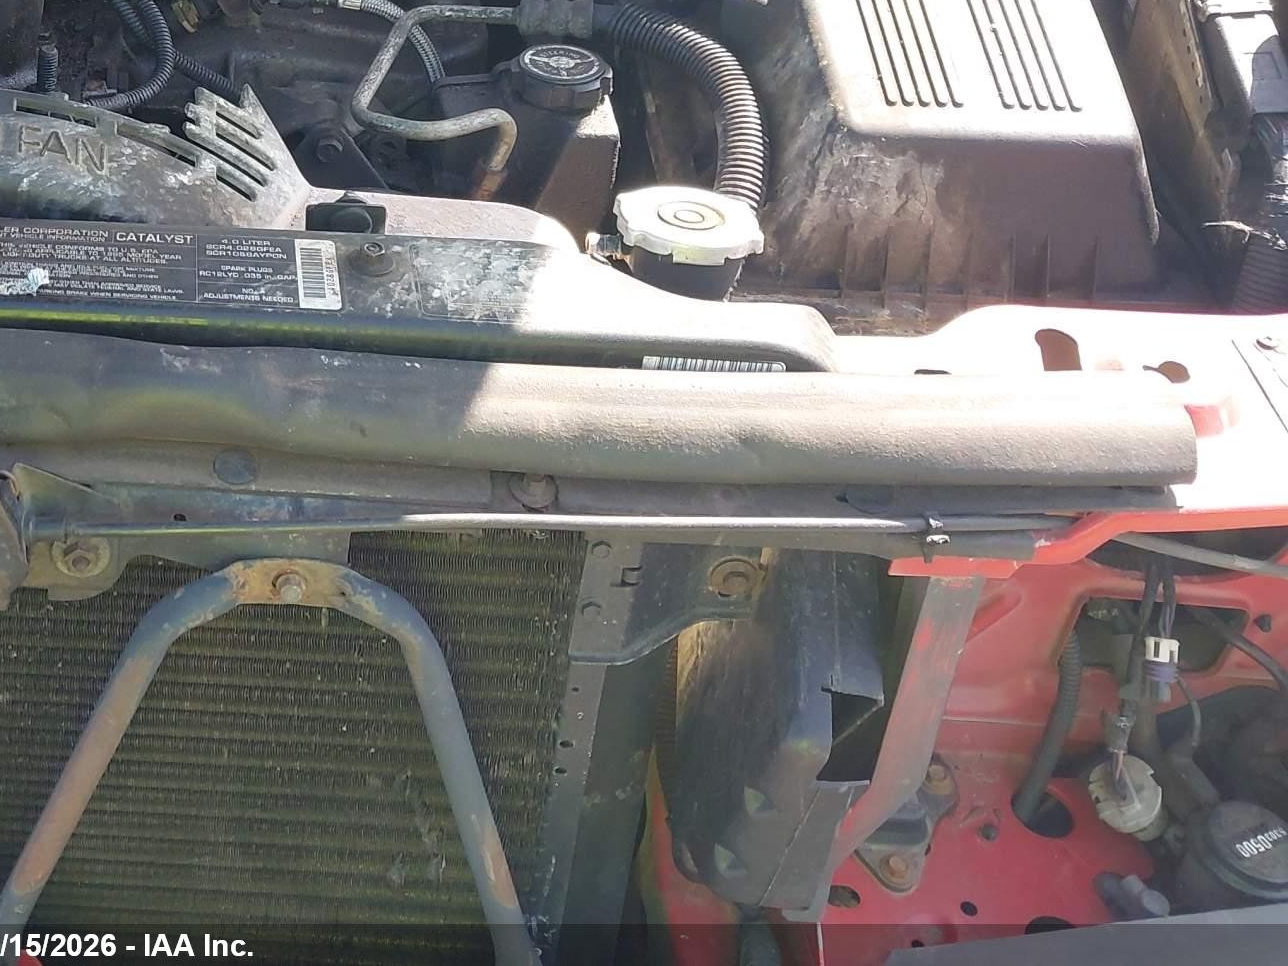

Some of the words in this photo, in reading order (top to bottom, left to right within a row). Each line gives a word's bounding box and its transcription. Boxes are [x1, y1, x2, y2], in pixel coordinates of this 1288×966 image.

[17, 123, 110, 178] FAN
[9, 232, 44, 240] VEHICLE
[46, 234, 105, 242] INFORMATION
[23, 227, 109, 237] CORPORATION
[116, 232, 193, 244] CATALYST
[203, 292, 260, 301] ADJUSTMENTS
[262, 295, 294, 303] NEEDED
